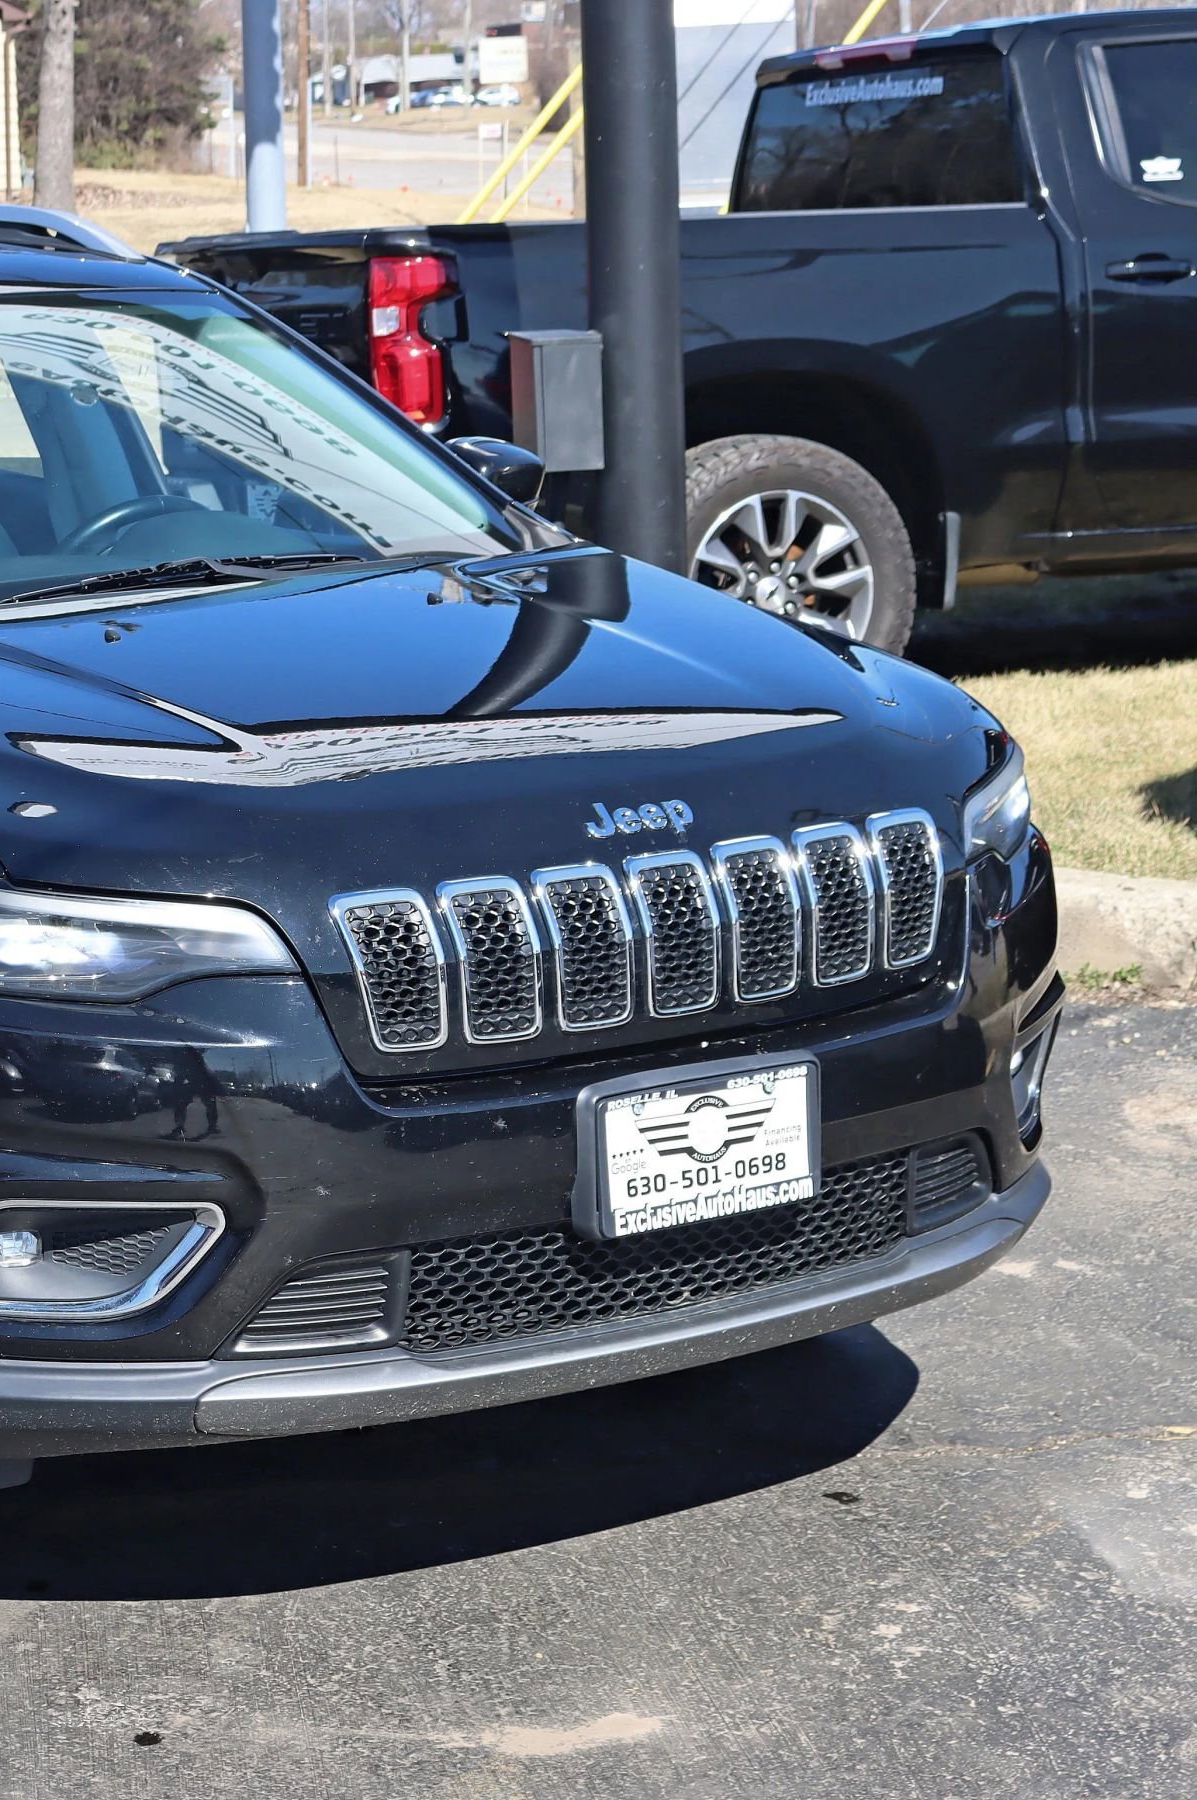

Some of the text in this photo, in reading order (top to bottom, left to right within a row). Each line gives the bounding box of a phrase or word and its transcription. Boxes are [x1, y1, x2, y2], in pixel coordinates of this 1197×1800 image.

[584, 799, 694, 839] Jeep
[727, 1065, 808, 1089] 630-501-0698
[607, 1089, 679, 1112] ROSELLE, IL
[690, 1097, 724, 1112] EXCLUSIVE
[611, 1157, 647, 1175] Google
[692, 1146, 727, 1163] AUTOHAUS
[626, 1152, 786, 1198] 630-501-0698
[614, 1175, 815, 1236] ExclusiveAutoHaus.com
